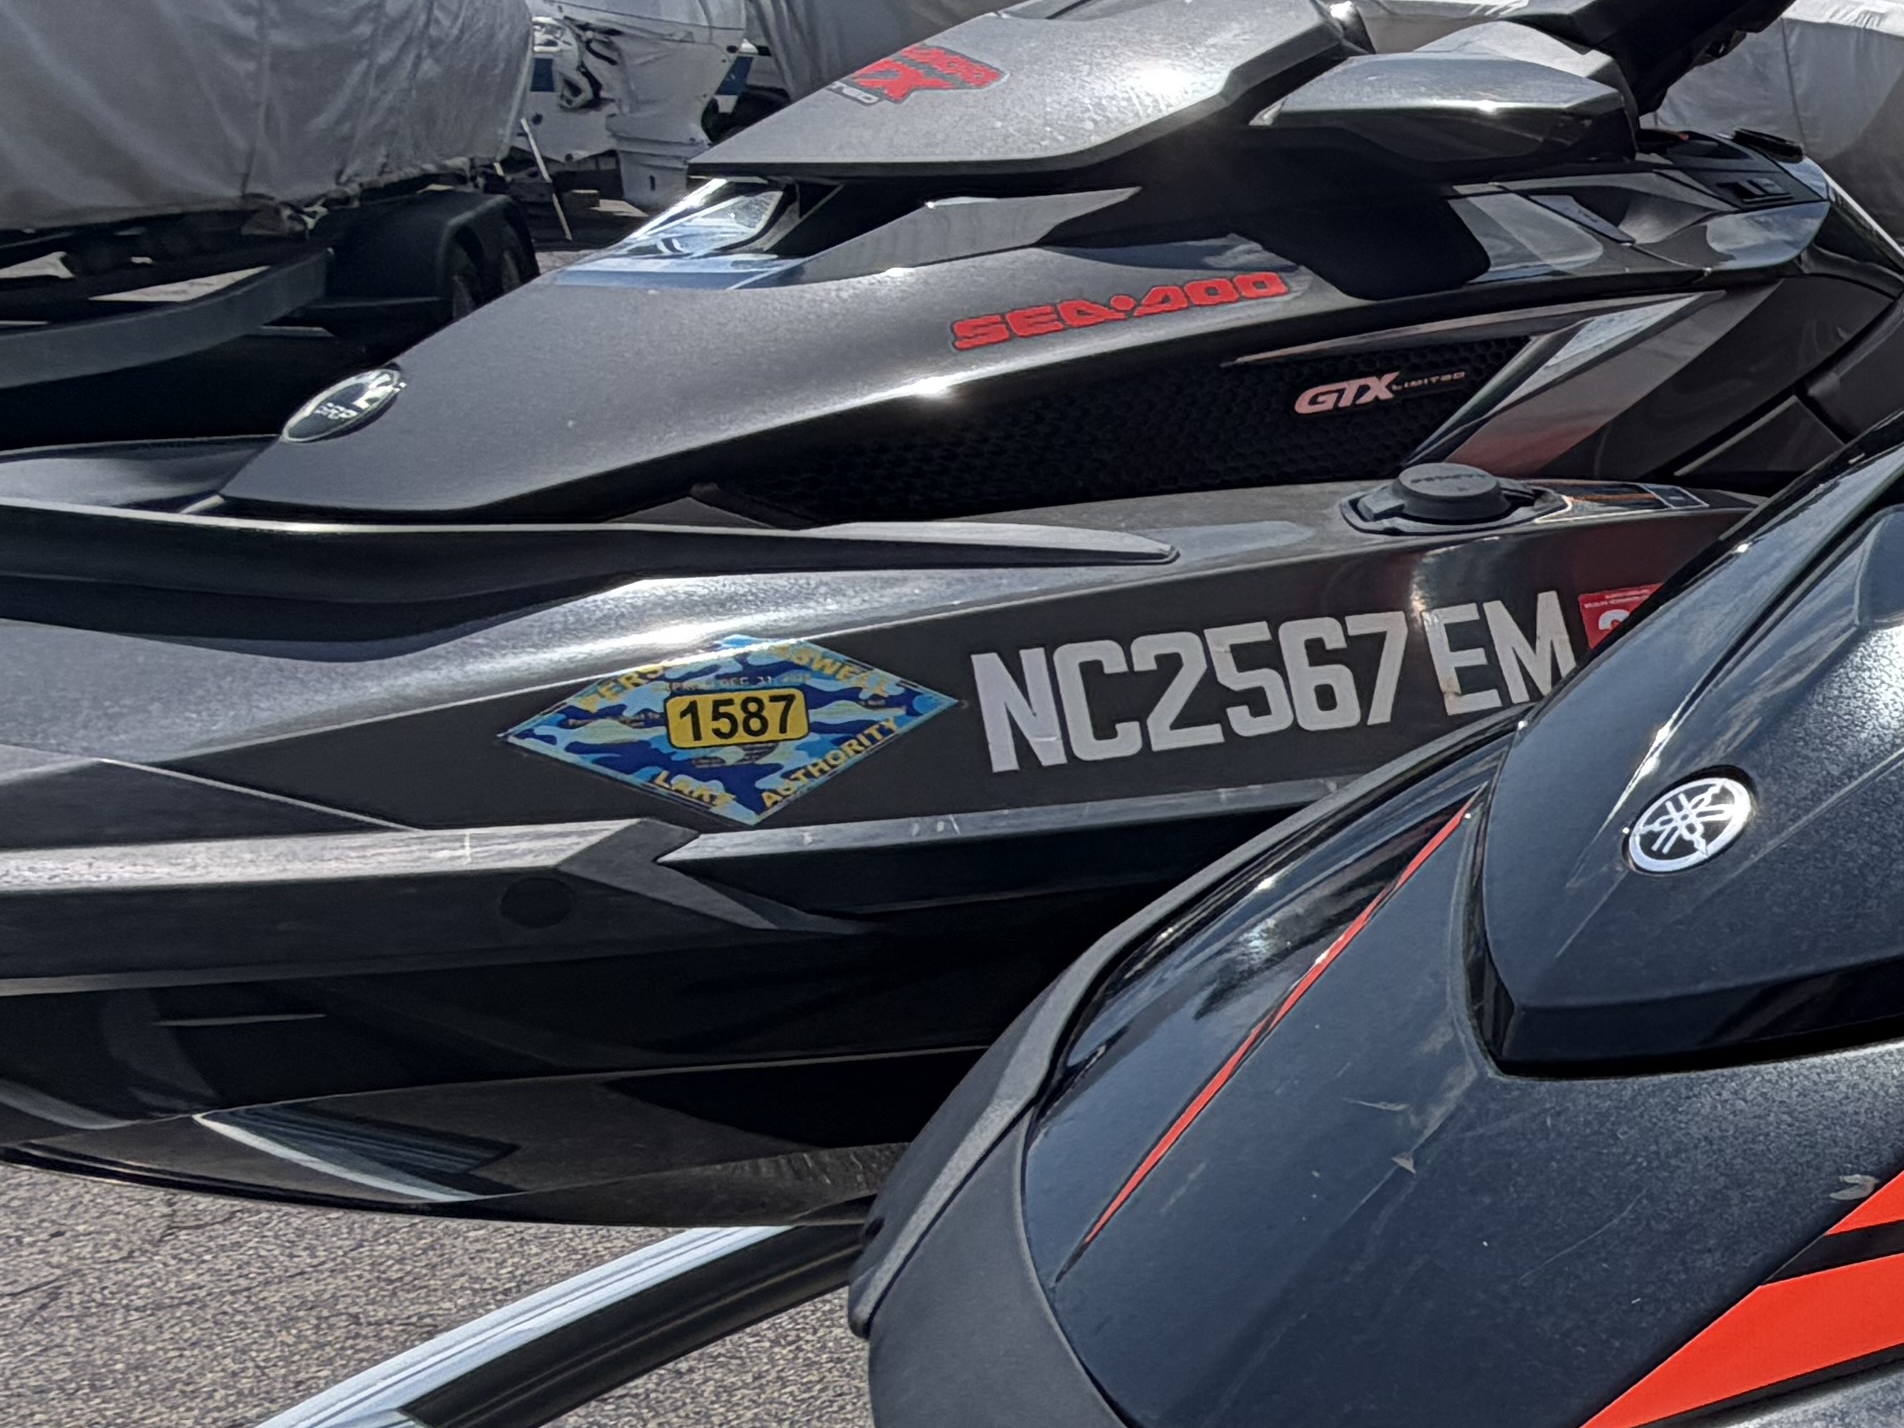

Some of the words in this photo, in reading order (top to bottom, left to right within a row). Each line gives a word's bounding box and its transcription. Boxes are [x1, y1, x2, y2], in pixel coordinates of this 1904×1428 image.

[1295, 372, 1399, 414] GTX
[971, 611, 1407, 773] NC2567
[1419, 591, 1577, 717] EM
[679, 694, 797, 742] 1587
[760, 716, 900, 809] AUTHORITY
